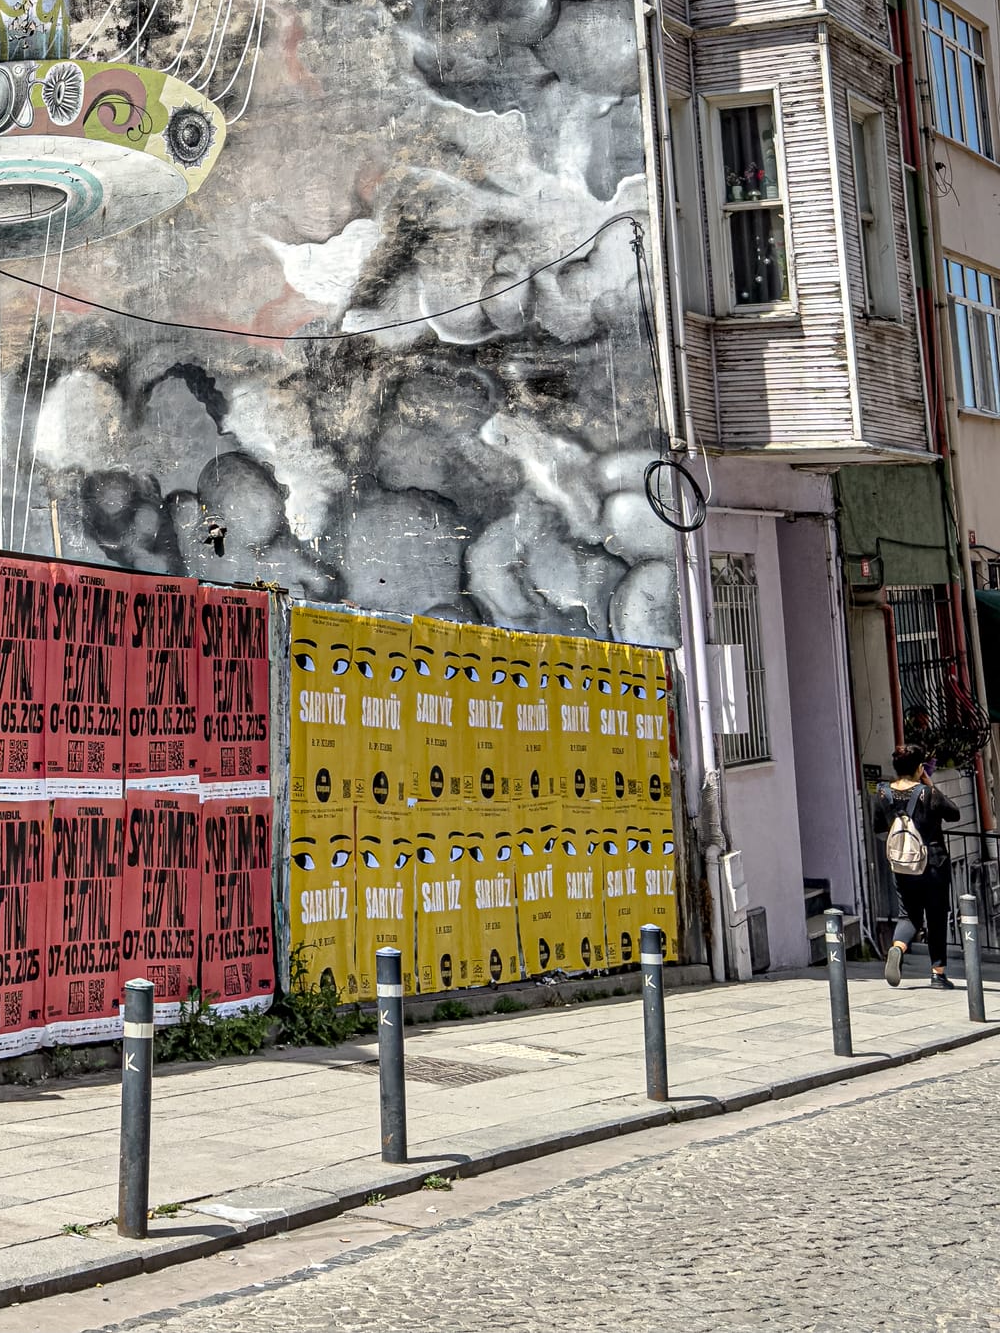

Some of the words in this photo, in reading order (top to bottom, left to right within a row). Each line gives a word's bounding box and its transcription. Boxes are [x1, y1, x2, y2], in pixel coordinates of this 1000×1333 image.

[300, 690, 326, 724] SARI
[327, 686, 347, 726] YÜZ
[362, 696, 384, 729] SARI
[384, 693, 401, 731] YÜZ
[416, 692, 438, 725] SARI
[301, 889, 327, 925] SARI
[327, 879, 349, 921] YÜZ
[365, 886, 389, 920] SARI
